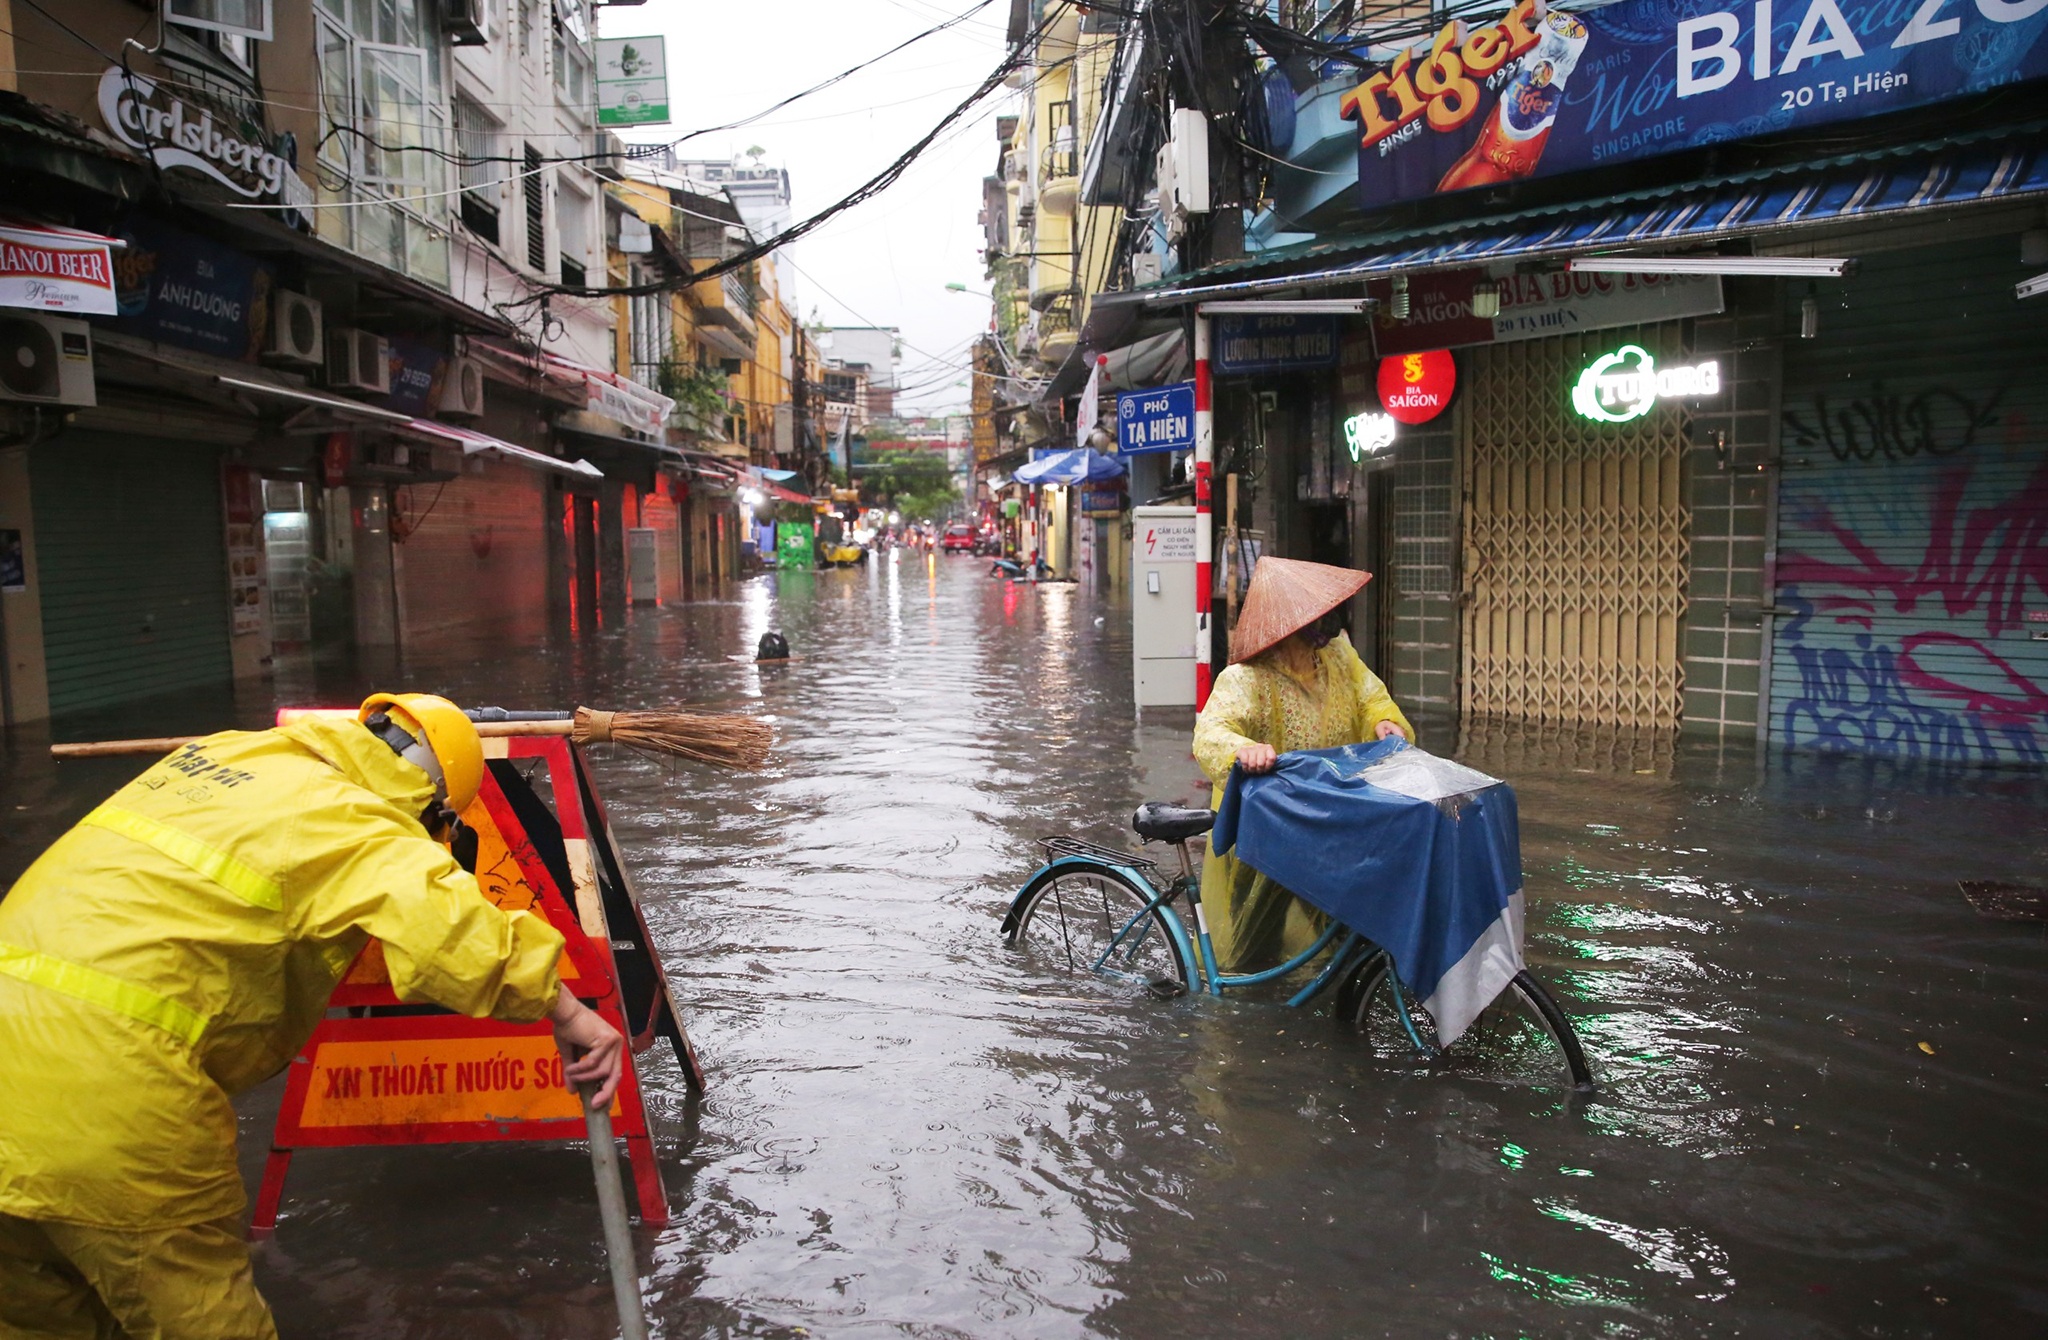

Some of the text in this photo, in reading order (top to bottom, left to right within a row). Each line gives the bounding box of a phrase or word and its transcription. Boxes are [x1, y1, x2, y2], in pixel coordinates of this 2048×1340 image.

[1586, 50, 1632, 76] PARIS
[1677, 0, 1865, 98] BIA
[1340, 0, 1541, 147] Tiger
[1781, 70, 1909, 111] 20 Tạ Hiện
[1378, 118, 1422, 156] SINCE
[1486, 56, 1525, 88] 1932
[98, 65, 283, 197] Carlsberg
[1592, 116, 1686, 161] SINGAPORE
[57, 253, 107, 283] BEER
[25, 280, 80, 301] Premium
[1424, 291, 1446, 304] BIA
[1498, 274, 1545, 308] BIA
[1498, 321, 1514, 332] 20
[1143, 394, 1169, 414] PHỐ
[1389, 394, 1438, 407] SAIGON
[1406, 386, 1421, 395] BIA
[1127, 413, 1187, 447] TẠ HIỆN
[325, 1067, 361, 1100] XN
[369, 1056, 448, 1097] THOÁT
[456, 1051, 526, 1093] NƯỚC
